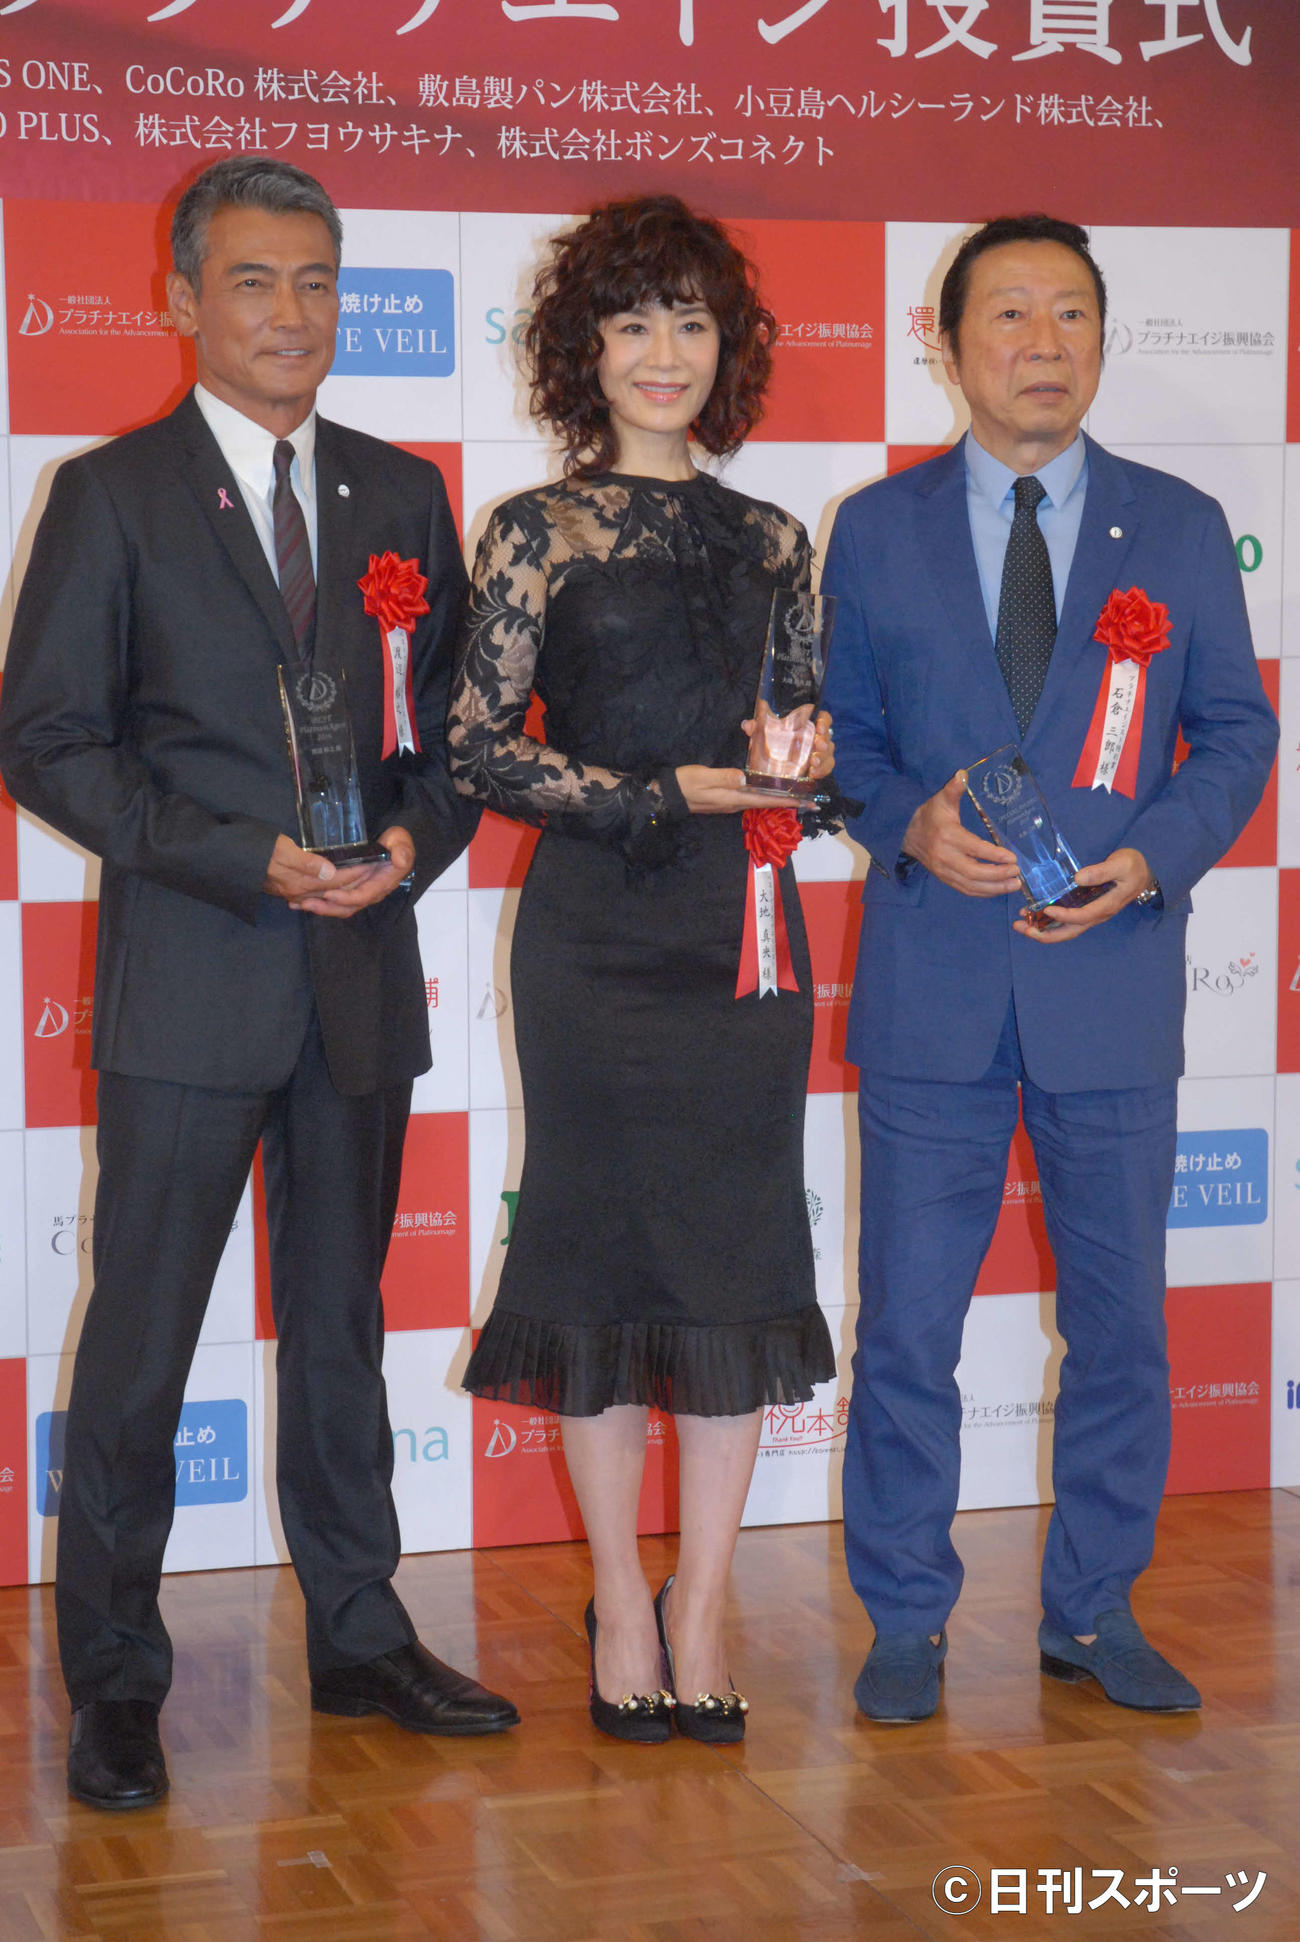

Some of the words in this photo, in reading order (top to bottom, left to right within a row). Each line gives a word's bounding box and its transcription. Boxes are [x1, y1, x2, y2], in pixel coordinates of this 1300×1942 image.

[125, 65, 245, 97] CoCoRo
[497, 125, 834, 166] 株式会社ボンズコネクト
[59, 295, 112, 305] 一般社団法人
[340, 293, 423, 314] 焼け止め
[776, 322, 873, 339] エイジ振興協会
[1137, 331, 1275, 347] プラチナエイジ振興協会
[373, 328, 447, 353] VEIL
[73, 1009, 92, 1024] プ
[1198, 1182, 1261, 1206] VEIL
[53, 1215, 94, 1227] 馬プラ
[1170, 1381, 1260, 1400] エイジ振興協会
